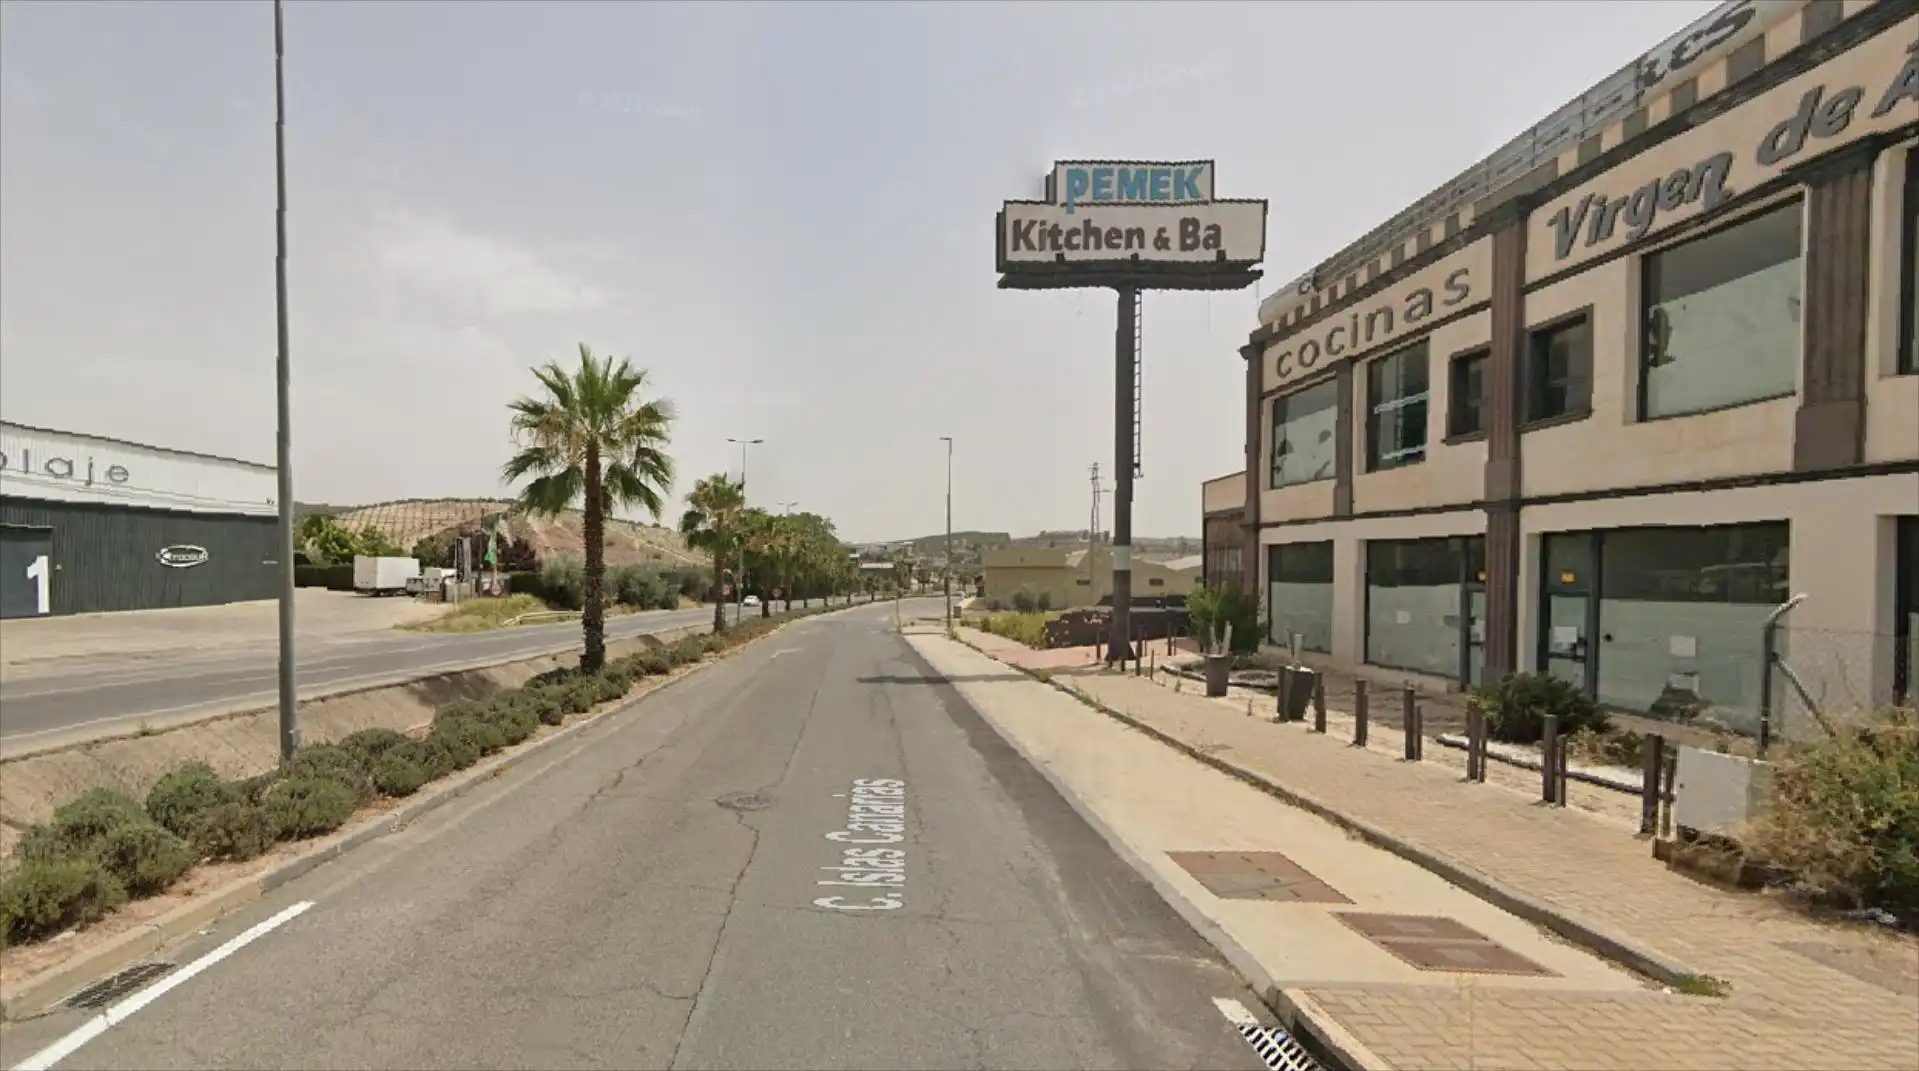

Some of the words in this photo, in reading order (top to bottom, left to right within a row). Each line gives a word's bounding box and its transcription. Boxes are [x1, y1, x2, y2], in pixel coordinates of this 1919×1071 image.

[1065, 166, 1205, 215] PEMEK
[1547, 152, 1735, 261] Virgen
[1757, 84, 1865, 166] de
[1011, 218, 1146, 251] Kitchen
[1152, 226, 1171, 251] &
[1179, 216, 1223, 251] Ba
[1276, 266, 1471, 378] cocinas
[27, 555, 50, 613] 1
